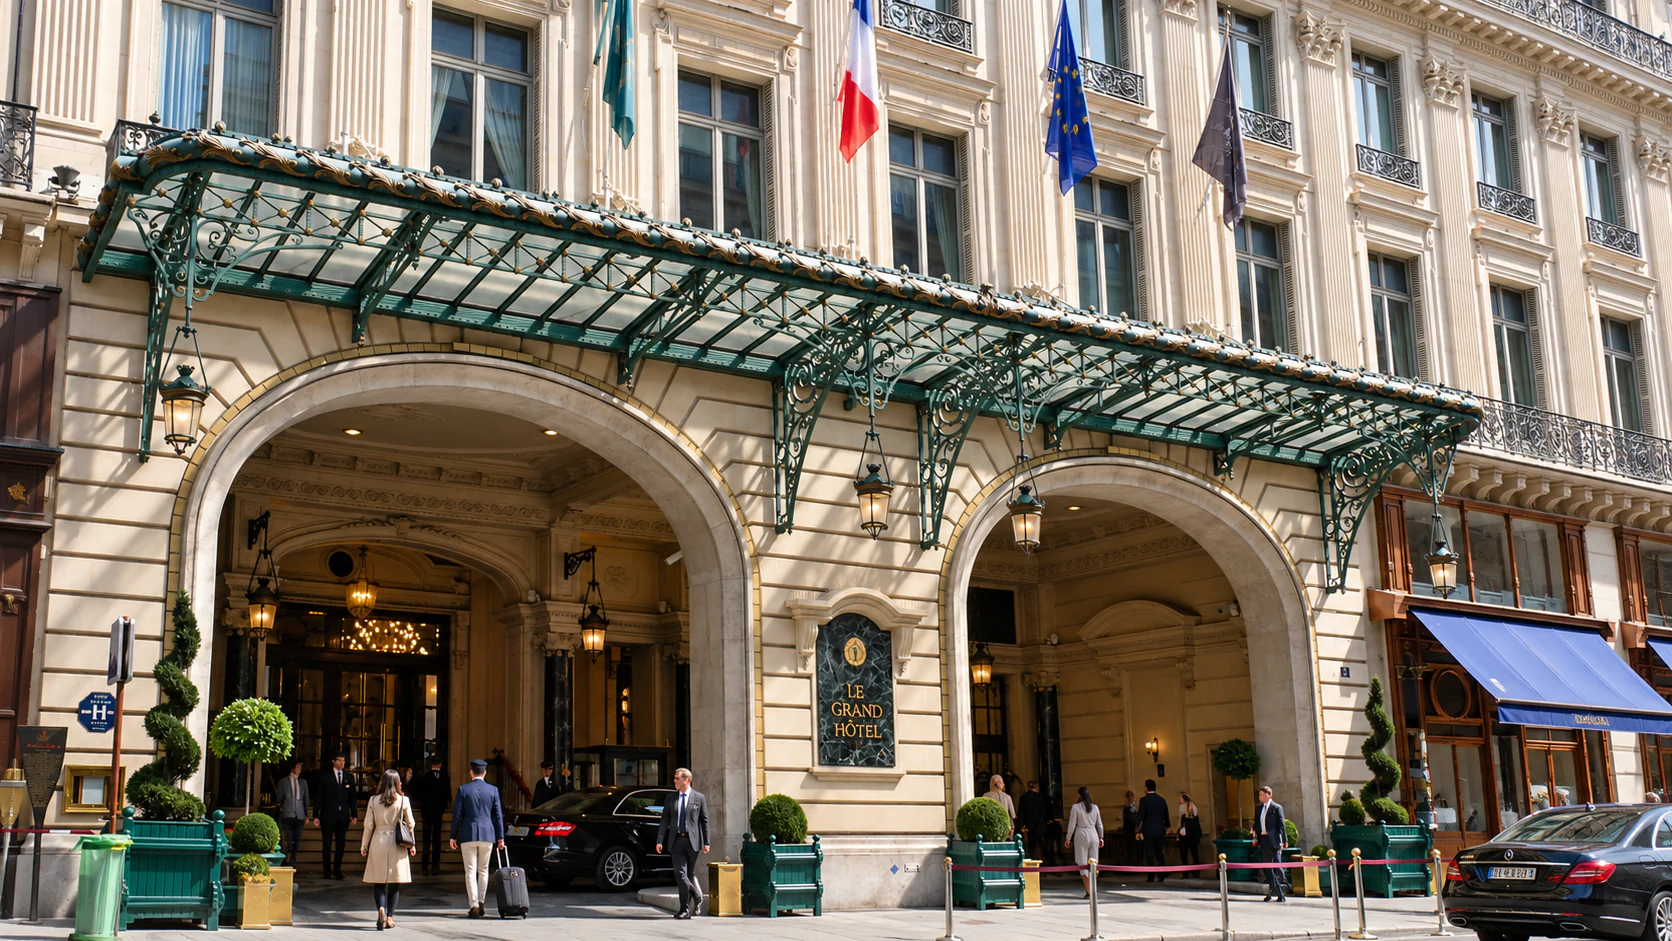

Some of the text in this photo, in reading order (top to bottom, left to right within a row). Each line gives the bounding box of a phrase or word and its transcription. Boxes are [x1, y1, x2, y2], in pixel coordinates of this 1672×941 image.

[847, 684, 864, 699] LE
[92, 704, 107, 720] H
[831, 702, 883, 719] GRAND
[834, 719, 883, 739] HÔTEL
